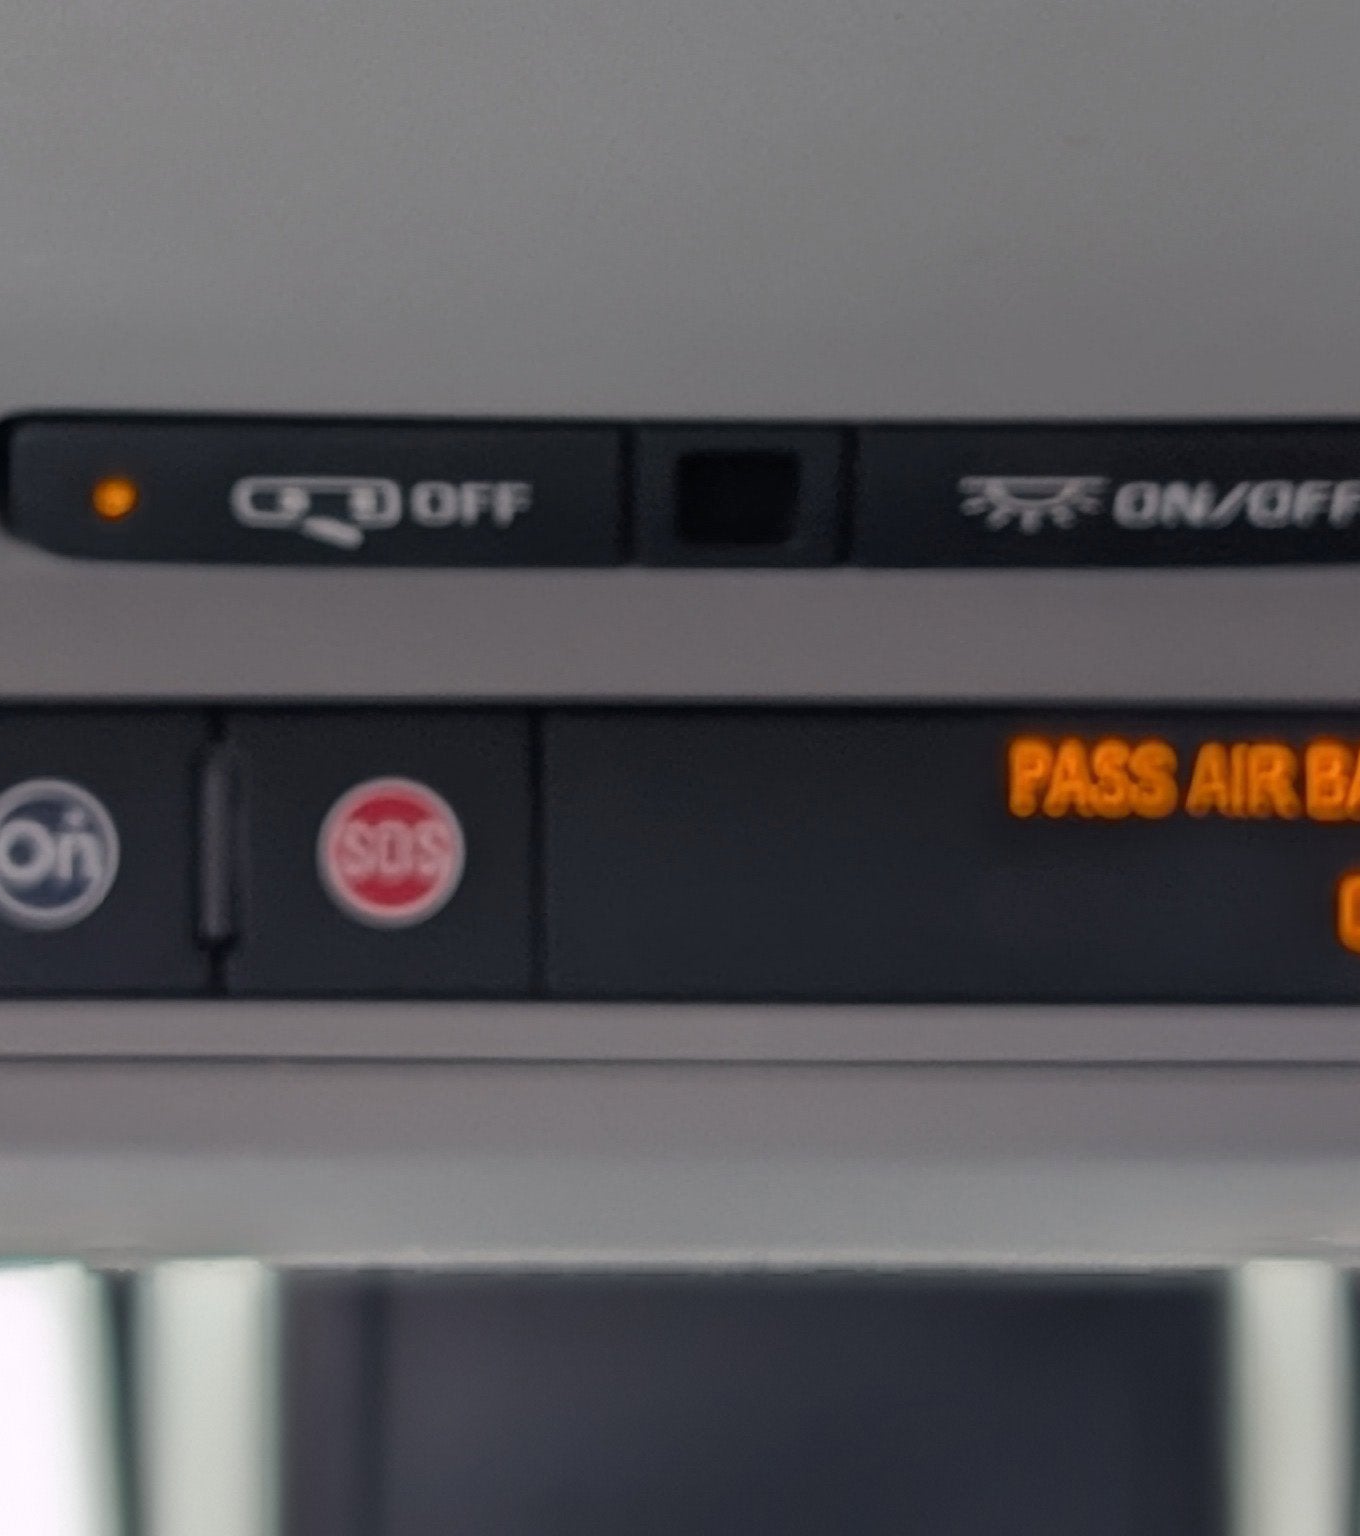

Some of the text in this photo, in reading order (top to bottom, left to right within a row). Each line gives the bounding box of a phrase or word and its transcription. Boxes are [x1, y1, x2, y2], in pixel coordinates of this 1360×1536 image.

[409, 480, 533, 528] OFF
[1008, 737, 1179, 819] PASS
[1185, 740, 1298, 819] AIR
[341, 818, 451, 880] SOS
